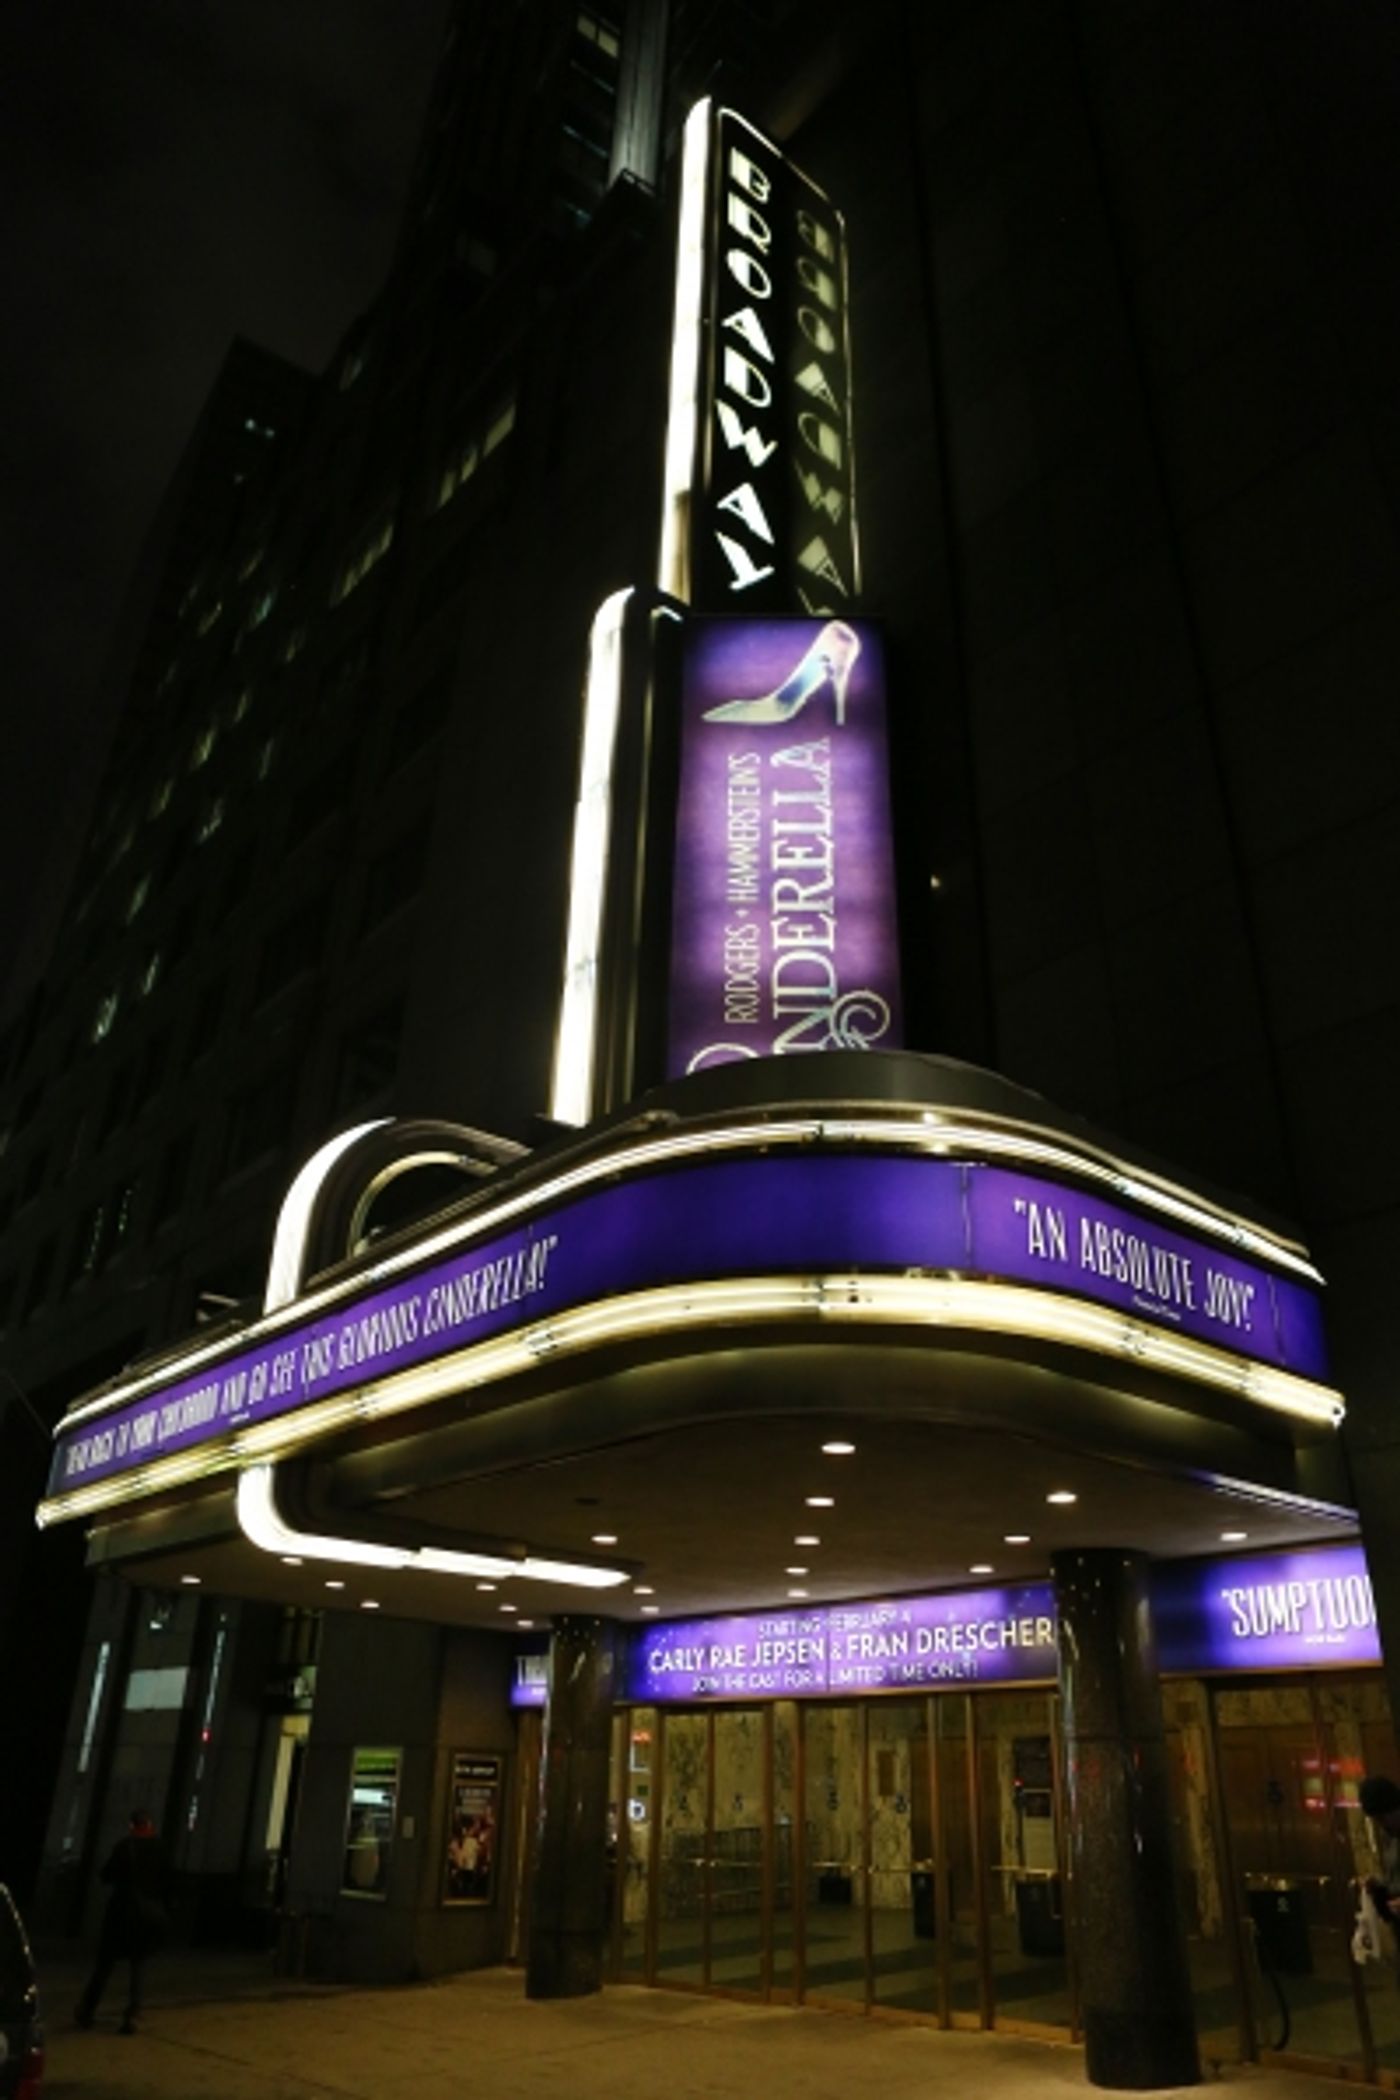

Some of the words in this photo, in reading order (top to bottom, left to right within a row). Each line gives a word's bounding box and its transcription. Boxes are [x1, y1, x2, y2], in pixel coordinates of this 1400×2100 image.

[715, 146, 777, 590] BROADWAY
[770, 736, 839, 1055] NDERELLA
[725, 923, 759, 1024] RODGERS
[1014, 1198, 1068, 1263] "AN
[1079, 1217, 1197, 1311] ABSOLUTE
[648, 1647, 706, 1675] CARLY
[709, 1645, 745, 1669] RAE
[751, 1637, 826, 1669] JEPSEN
[831, 1641, 842, 1661] &
[847, 1632, 908, 1661] FRAN
[918, 1617, 1054, 1655] DRESCHER
[758, 1615, 821, 1639] STARTING
[829, 1608, 898, 1634] FEBRUARY
[692, 1673, 720, 1694] JOIN
[723, 1673, 747, 1692] THE
[749, 1671, 781, 1690] CAST
[784, 1668, 814, 1688] FOR
[828, 1666, 885, 1687] LIMITED
[888, 1663, 926, 1683] TIME
